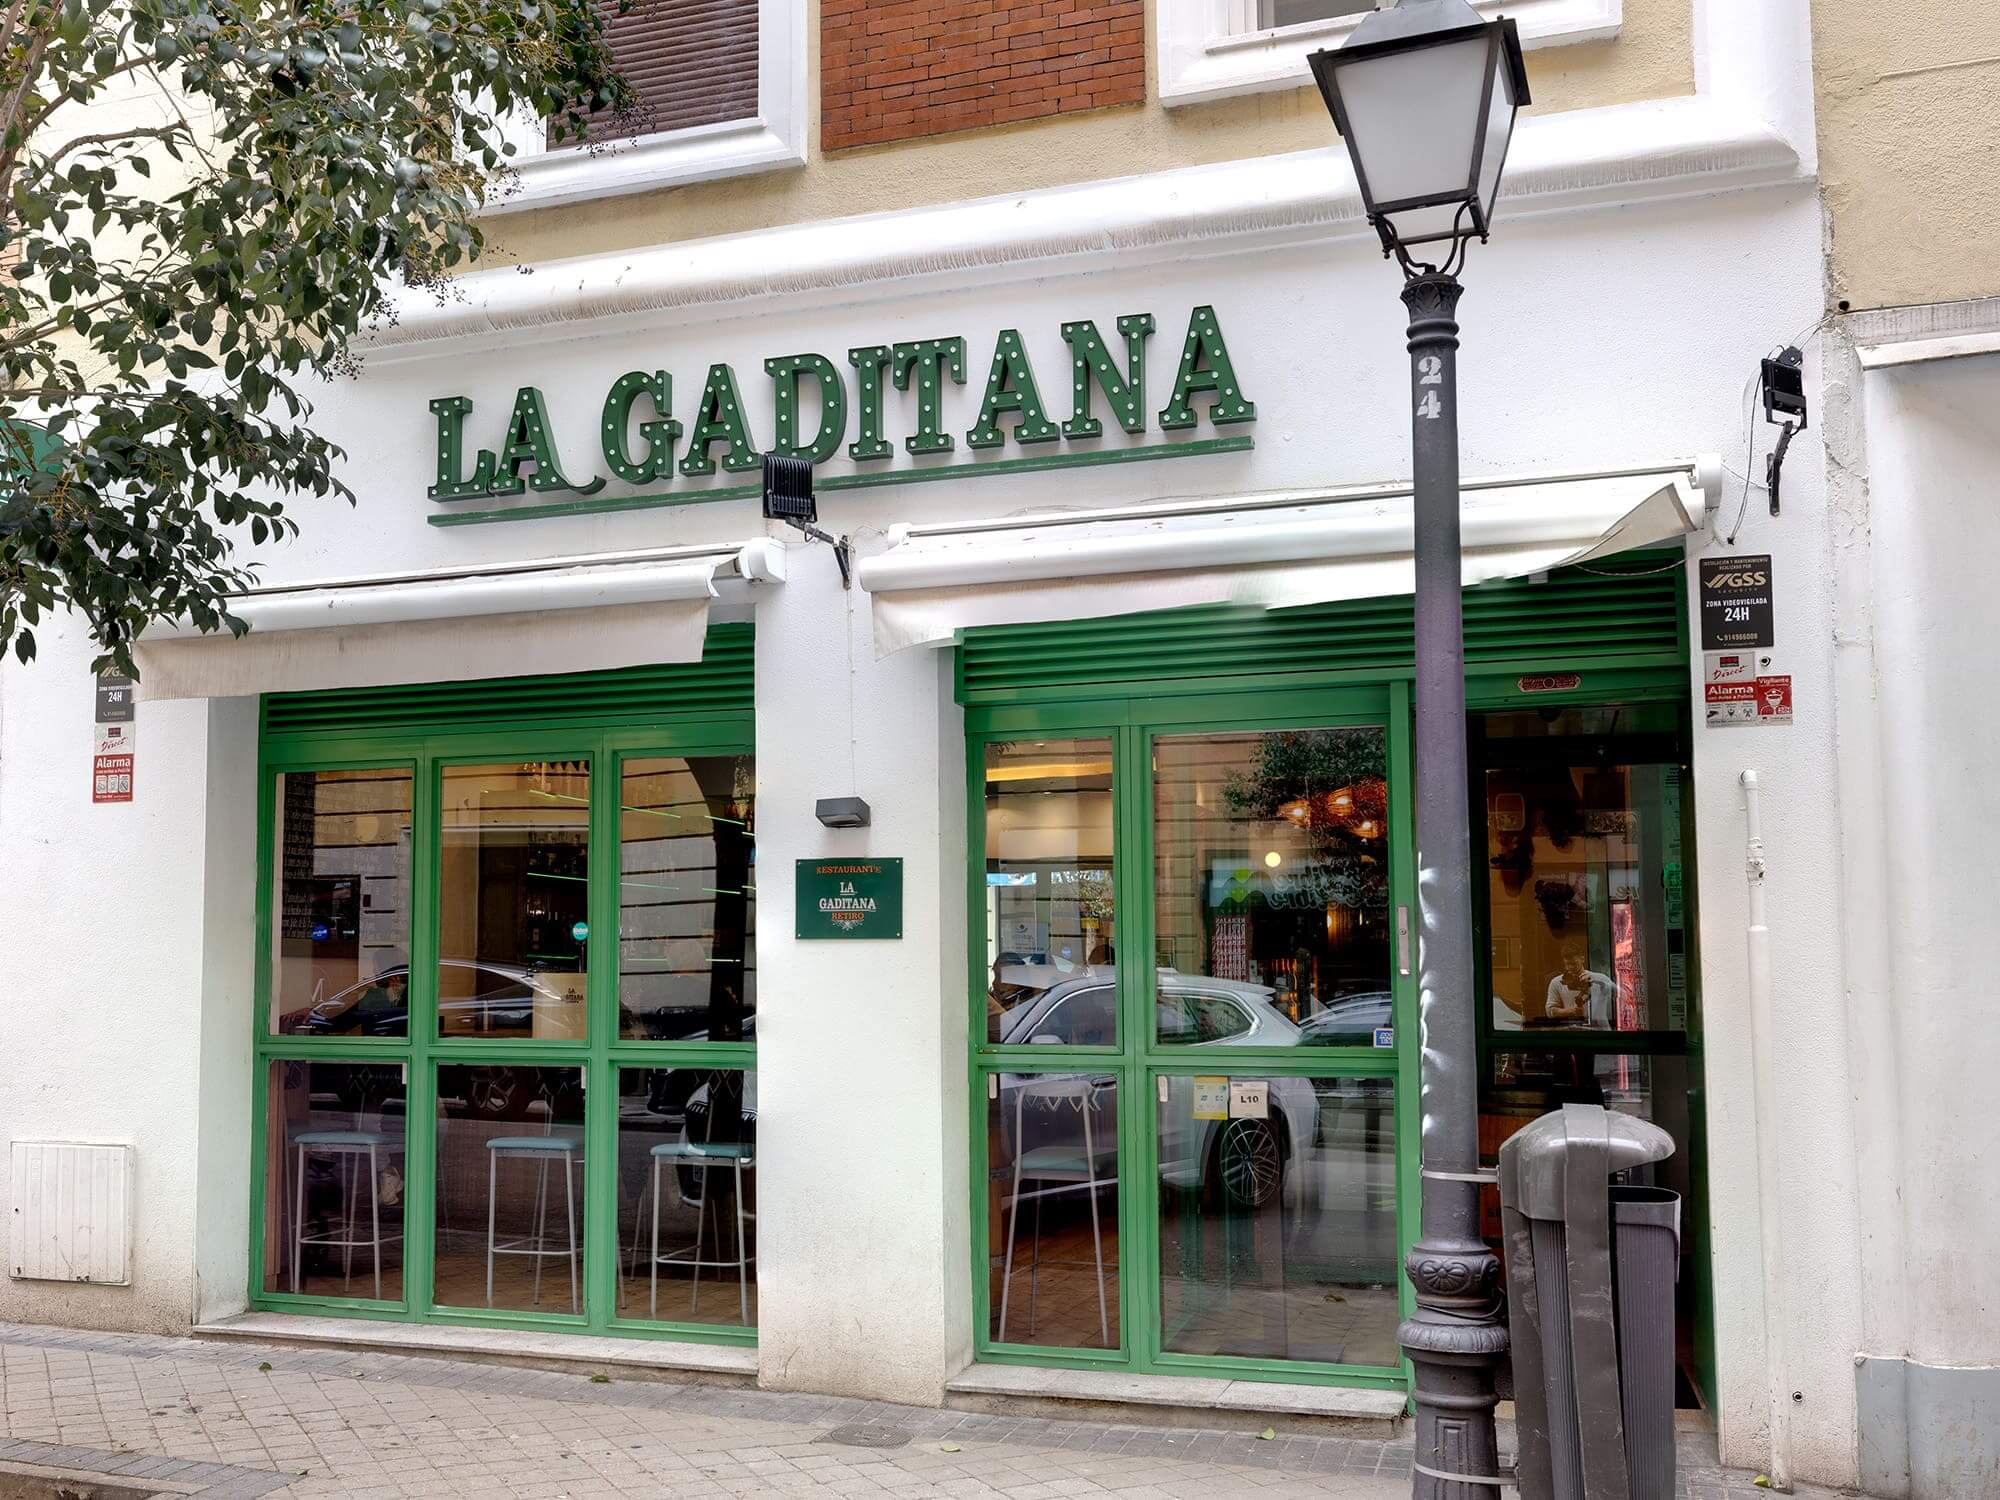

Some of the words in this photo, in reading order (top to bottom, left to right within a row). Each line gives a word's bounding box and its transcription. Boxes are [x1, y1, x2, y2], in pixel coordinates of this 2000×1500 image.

[428, 386, 606, 502] LA
[601, 305, 1258, 485] GADITANA
[1728, 571, 1766, 588] GSS
[1706, 600, 1721, 608] ZONA
[1725, 606, 1749, 622] 24H
[1708, 685, 1754, 696] Alarma
[107, 691, 122, 703] 24H
[96, 757, 130, 769] Alarma
[816, 865, 881, 874] RESTAURANTE
[840, 882, 857, 893] LA
[819, 898, 877, 910] GADITANA
[832, 912, 864, 921] RETIRO
[1241, 1095, 1259, 1104] L10
